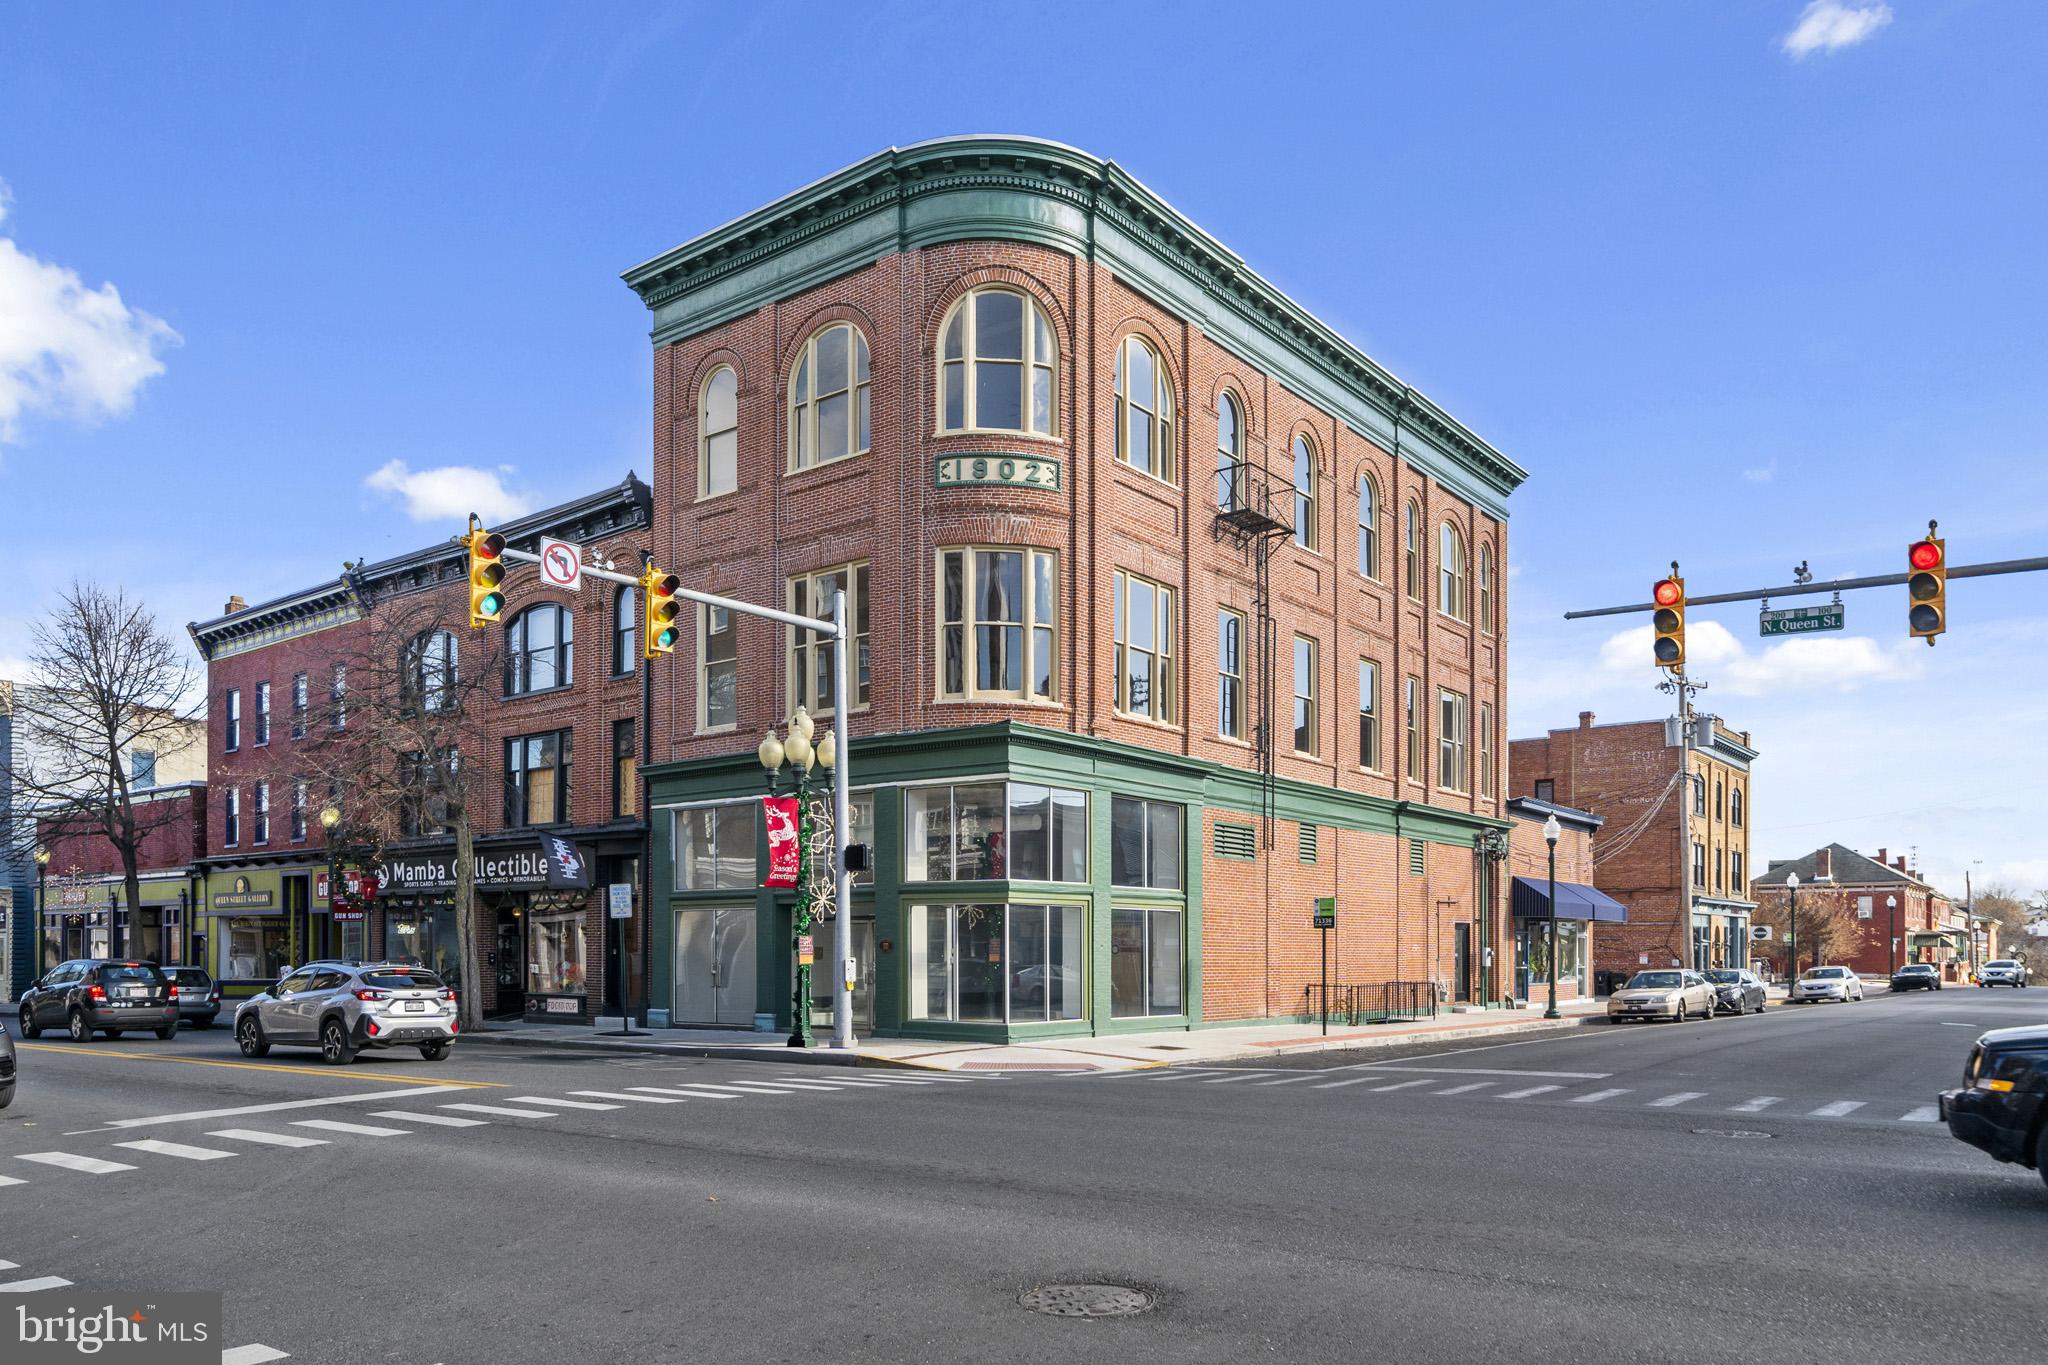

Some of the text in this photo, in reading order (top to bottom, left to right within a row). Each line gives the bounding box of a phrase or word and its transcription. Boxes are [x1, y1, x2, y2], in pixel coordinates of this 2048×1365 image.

[956, 458, 1041, 483] 1902
[1770, 607, 1832, 620] 200 100
[1763, 615, 1840, 633] N. Queen St.
[393, 853, 548, 882] Mamba Cllectible
[773, 864, 796, 872] Season's
[490, 876, 508, 884] COMICS
[513, 875, 546, 883] MEMORABILIA
[318, 882, 330, 896] GU
[215, 894, 268, 905] QUEEN STREET GALLERY
